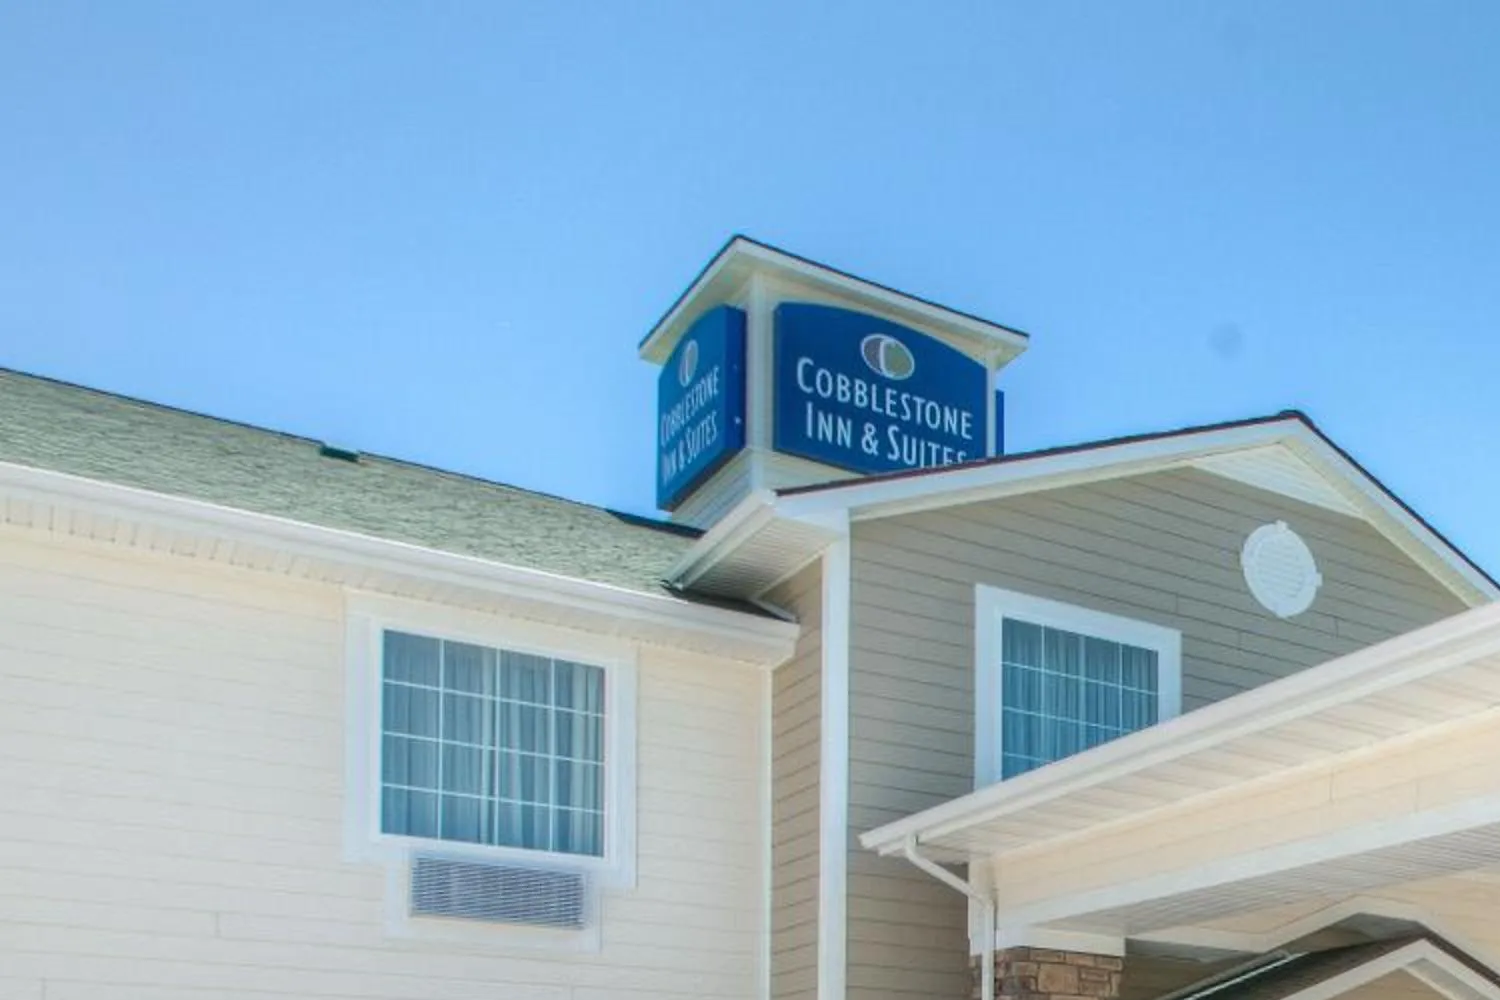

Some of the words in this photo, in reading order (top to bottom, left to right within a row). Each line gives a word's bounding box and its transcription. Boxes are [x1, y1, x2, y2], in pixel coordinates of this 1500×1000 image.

[797, 357, 973, 440] COBBLESTONE
[805, 401, 852, 449] INN
[861, 423, 879, 456] &
